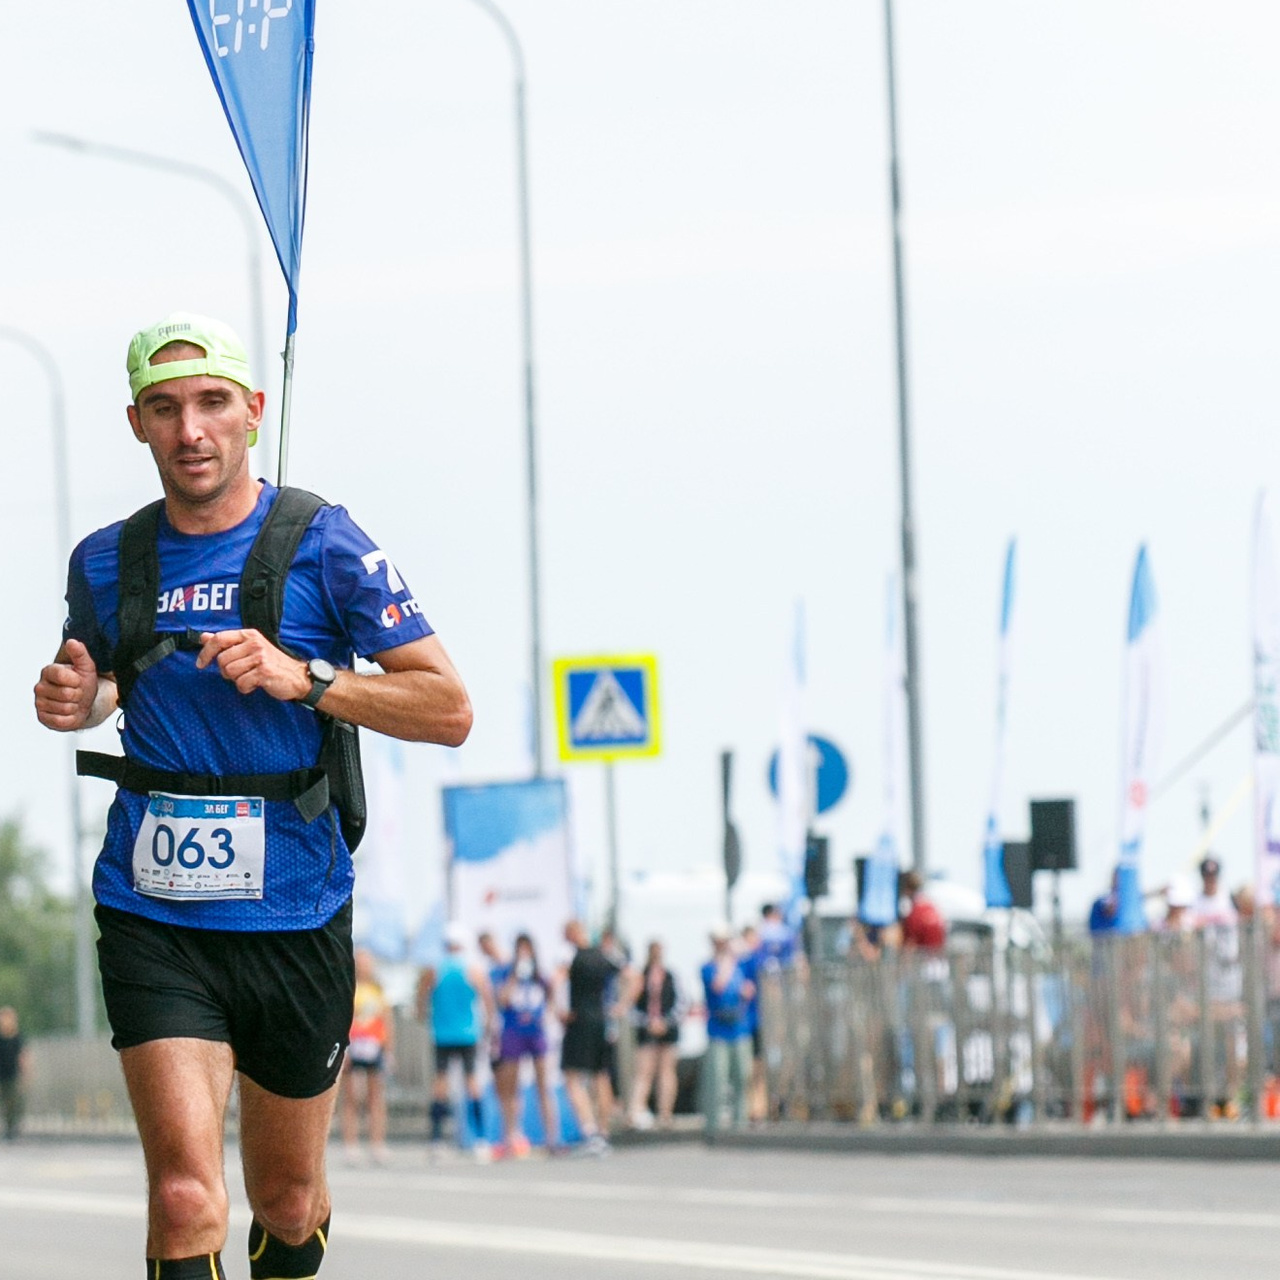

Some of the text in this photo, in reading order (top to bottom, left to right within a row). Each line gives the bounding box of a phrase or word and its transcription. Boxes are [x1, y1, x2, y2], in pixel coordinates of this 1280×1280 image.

[192, 583, 239, 611] БЕГ
[204, 804, 229, 814] ЗА БЕГ
[152, 824, 235, 870] 063
